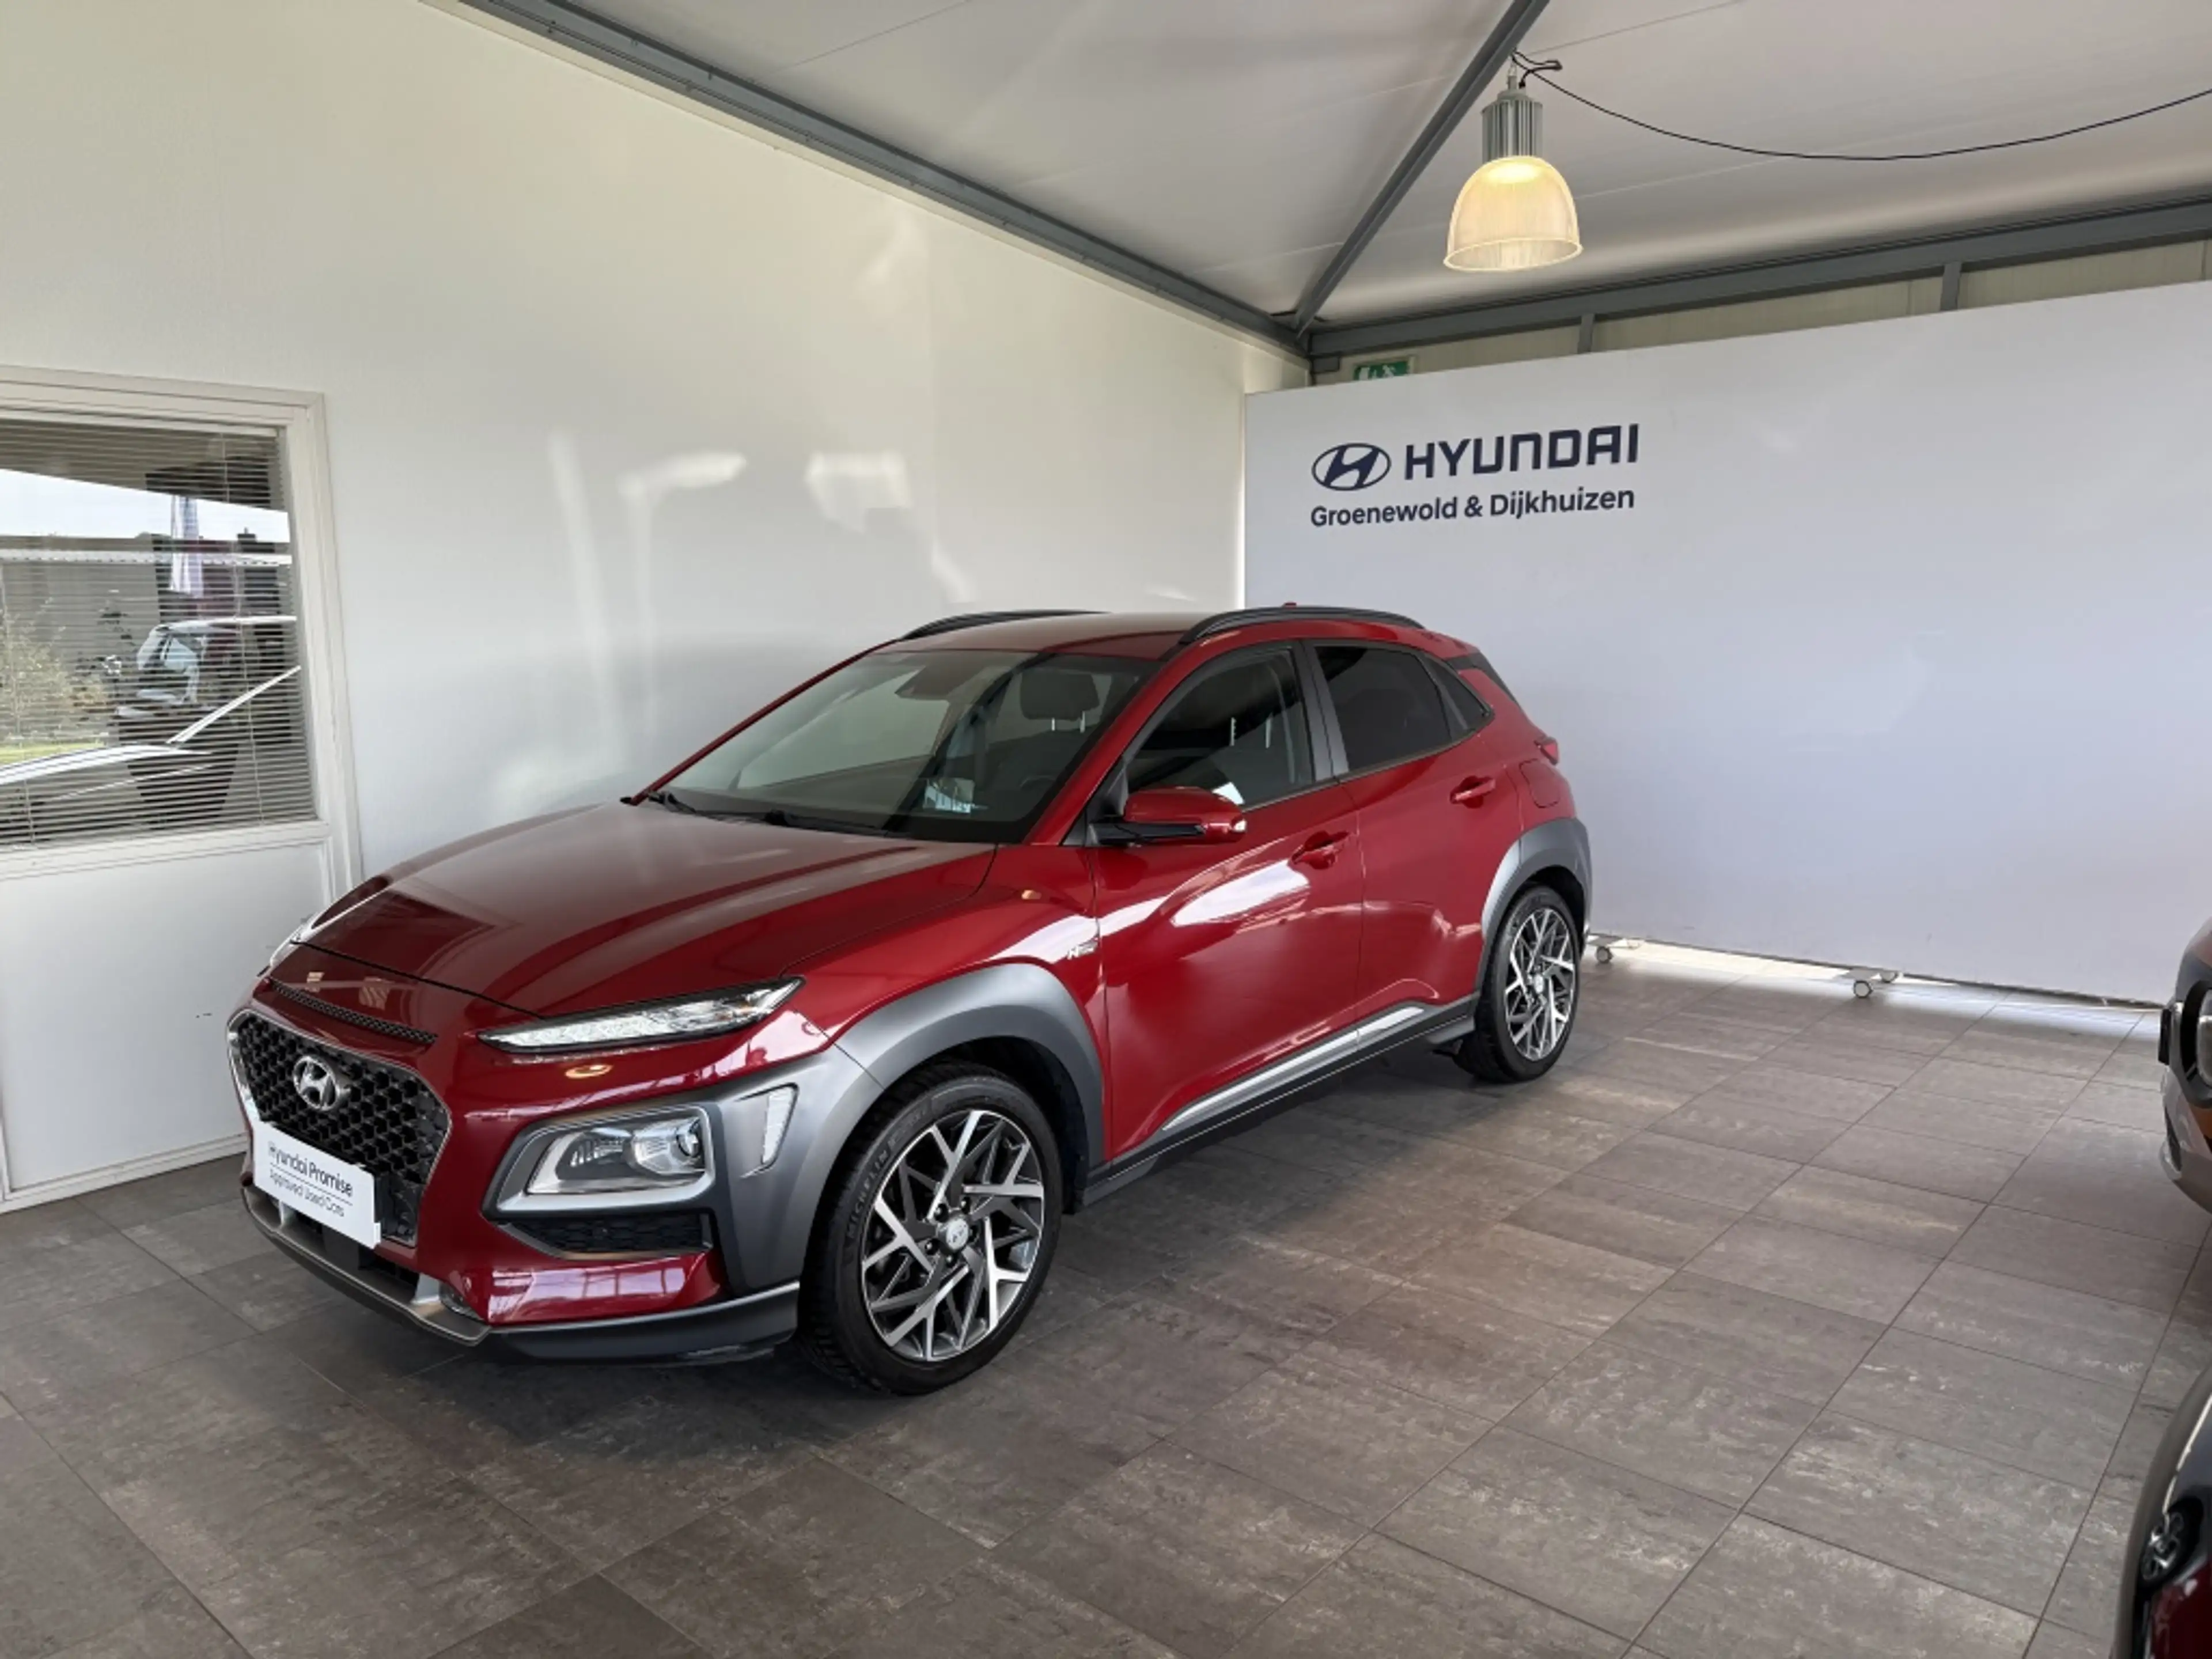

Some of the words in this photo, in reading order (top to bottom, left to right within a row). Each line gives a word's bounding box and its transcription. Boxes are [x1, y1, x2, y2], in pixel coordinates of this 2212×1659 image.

[1404, 423, 1639, 480] HYUNDAI
[1310, 497, 1458, 527] Groenewold
[1464, 495, 1483, 517] &
[1490, 486, 1635, 520] Dijkhuizen
[268, 1141, 308, 1176] Hyundai
[309, 1161, 354, 1198] Promise
[846, 1149, 888, 1238] MICHELIN
